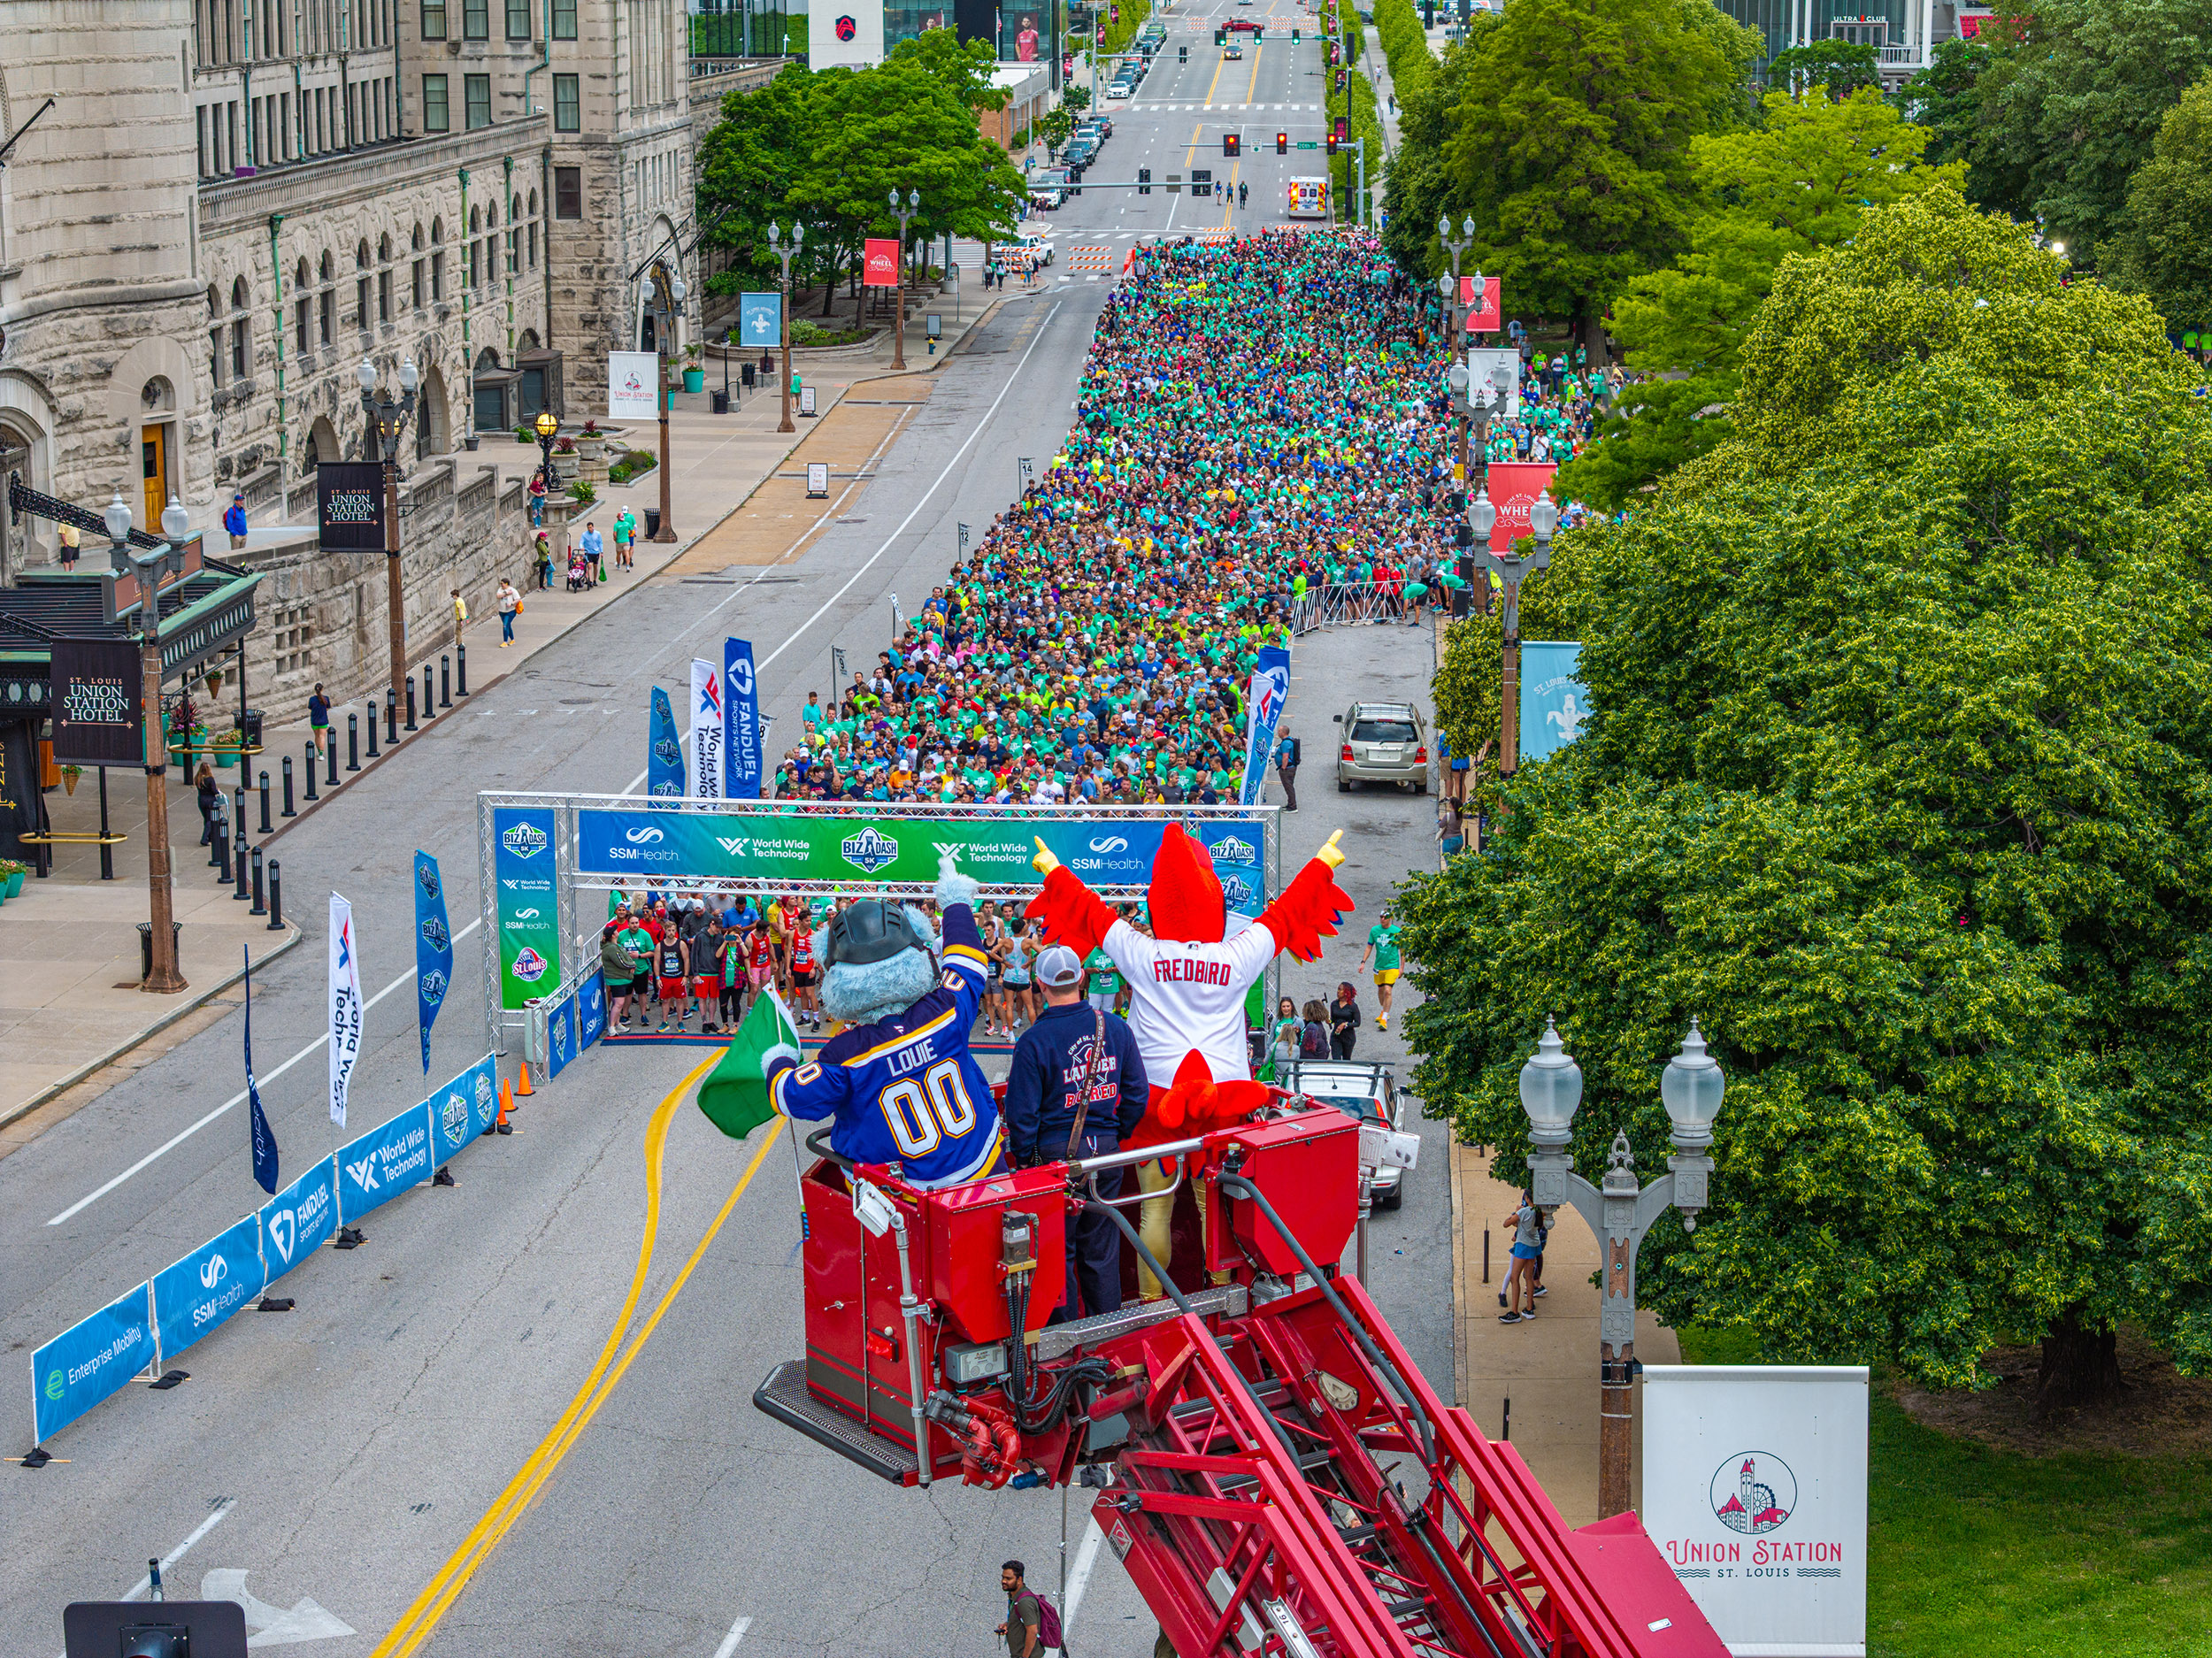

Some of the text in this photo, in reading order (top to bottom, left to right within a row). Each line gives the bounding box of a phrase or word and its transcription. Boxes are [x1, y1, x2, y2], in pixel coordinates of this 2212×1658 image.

[1022, 464, 1033, 473] 14
[331, 495, 371, 504] UNION
[326, 503, 375, 513] STATION
[1499, 505, 1529, 516] WHE
[332, 511, 371, 521] HOTEL
[960, 531, 969, 541] 12
[69, 684, 123, 698] UNION
[1533, 683, 1546, 695] ST.
[1545, 676, 1567, 688] LOUIS
[63, 695, 130, 710] STATION
[70, 708, 124, 722] HOTEL
[739, 700, 757, 780] FANDUEL
[656, 744, 666, 754] BIZ
[707, 726, 722, 773] World
[733, 736, 743, 779] NETWORK
[696, 725, 710, 812] Technoloy
[504, 833, 546, 844] BIZ DASH
[752, 838, 810, 849] World Wide
[610, 847, 679, 861] SSMHealth
[752, 848, 810, 861] Technology
[843, 841, 897, 855] BIZ DASH
[969, 843, 1027, 853] World Wide
[1210, 847, 1254, 857] BIZ DASH
[969, 852, 1027, 864] Technology
[1072, 857, 1143, 870] SSMHealth
[423, 924, 434, 936] BIZ
[1153, 958, 1232, 986] FREDBIRD
[346, 992, 360, 1053] orld
[1067, 1043, 1078, 1055] City
[887, 1038, 938, 1077] LOUIE
[878, 1057, 977, 1159] 00
[443, 1110, 454, 1128] BIZ
[378, 1136, 407, 1164] World
[405, 1126, 425, 1149] Wide
[382, 1147, 426, 1182] Technology
[296, 1182, 329, 1228] FANDUEL
[299, 1221, 315, 1243] SPORTS
[193, 1280, 244, 1327] SSMHealth
[68, 1348, 113, 1386] Enterprise
[112, 1325, 142, 1356] Mobility
[1666, 1538, 1841, 1565] UNION STATION
[1717, 1568, 1790, 1577] ST. LOUIS
